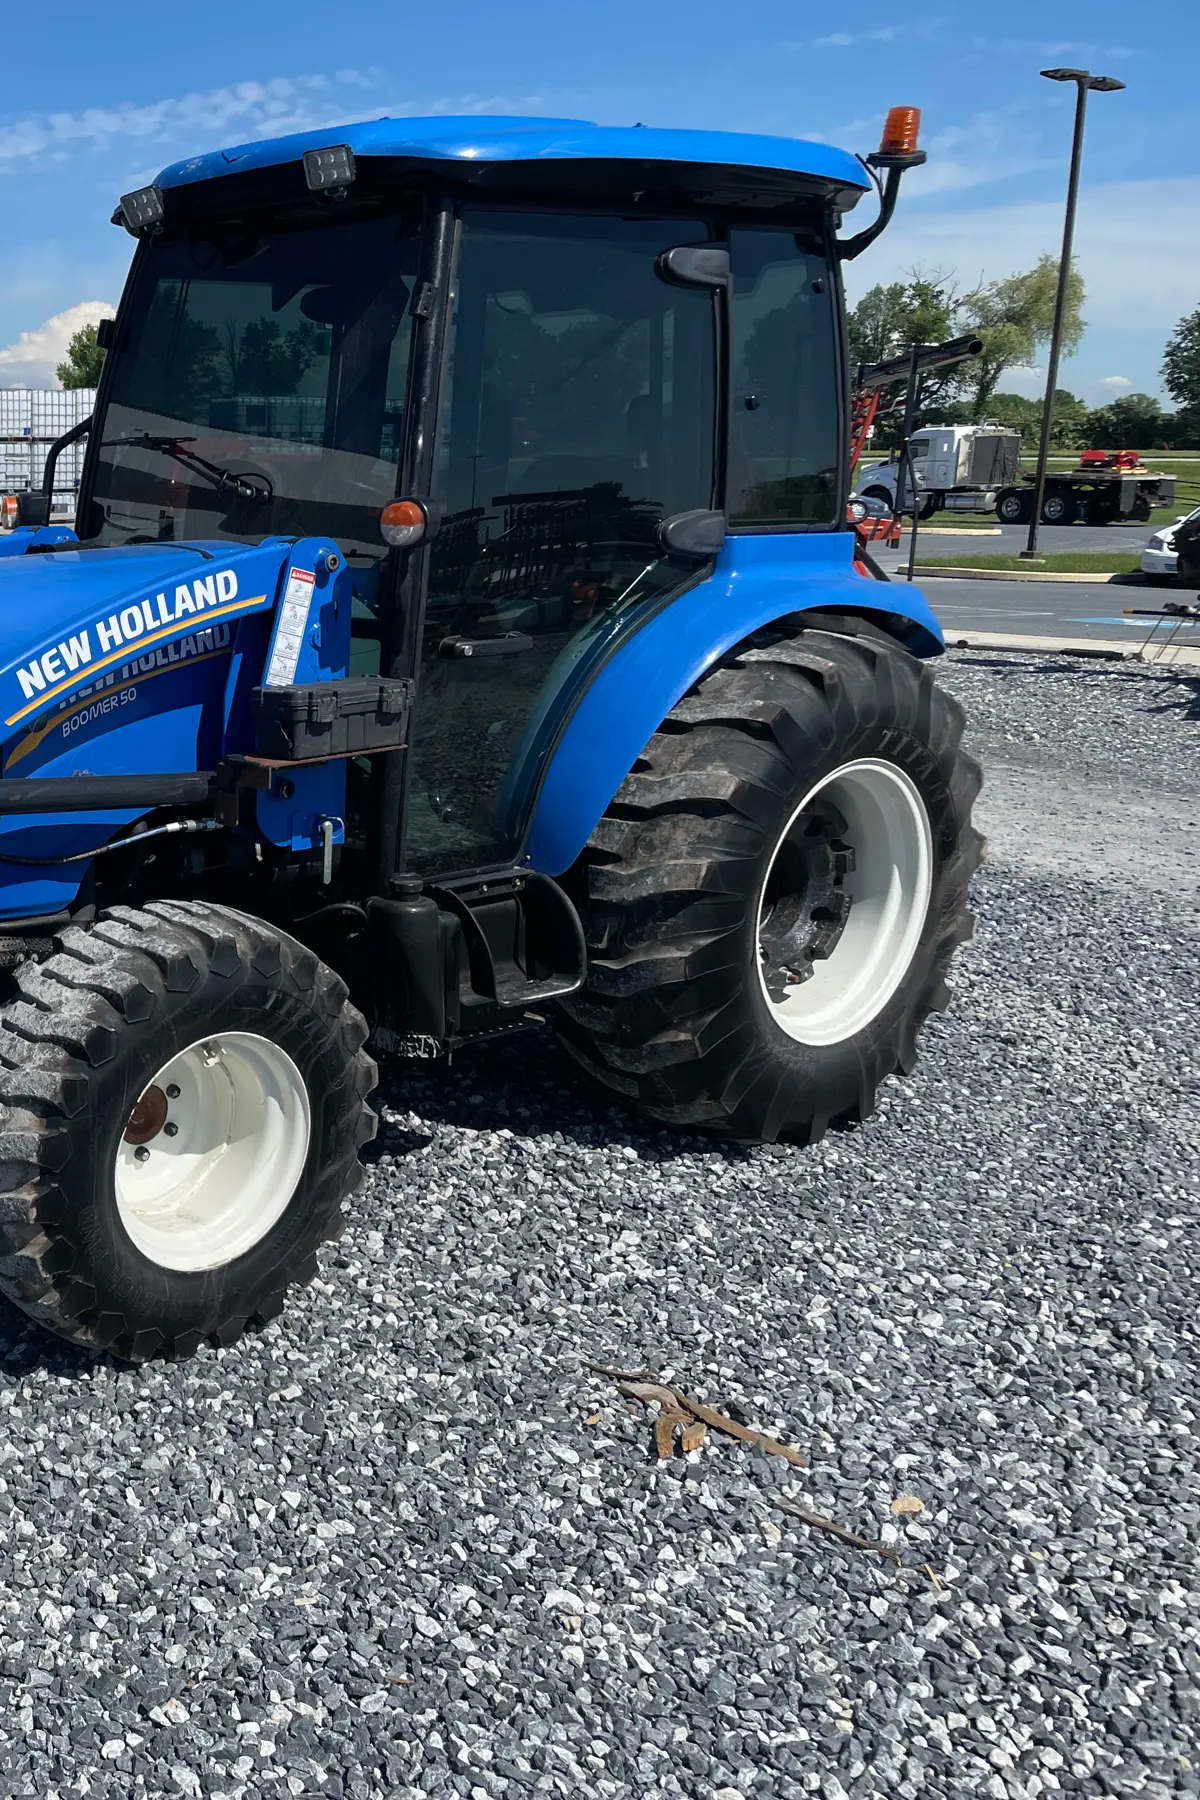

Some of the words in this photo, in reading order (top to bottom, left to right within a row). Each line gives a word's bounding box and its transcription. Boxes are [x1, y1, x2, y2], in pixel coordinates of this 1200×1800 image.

[16, 630, 92, 700] NEW
[96, 570, 239, 653] HOLLAND
[62, 695, 119, 738] BOOMER
[120, 687, 137, 706] 50
[874, 728, 950, 803] TITAN
